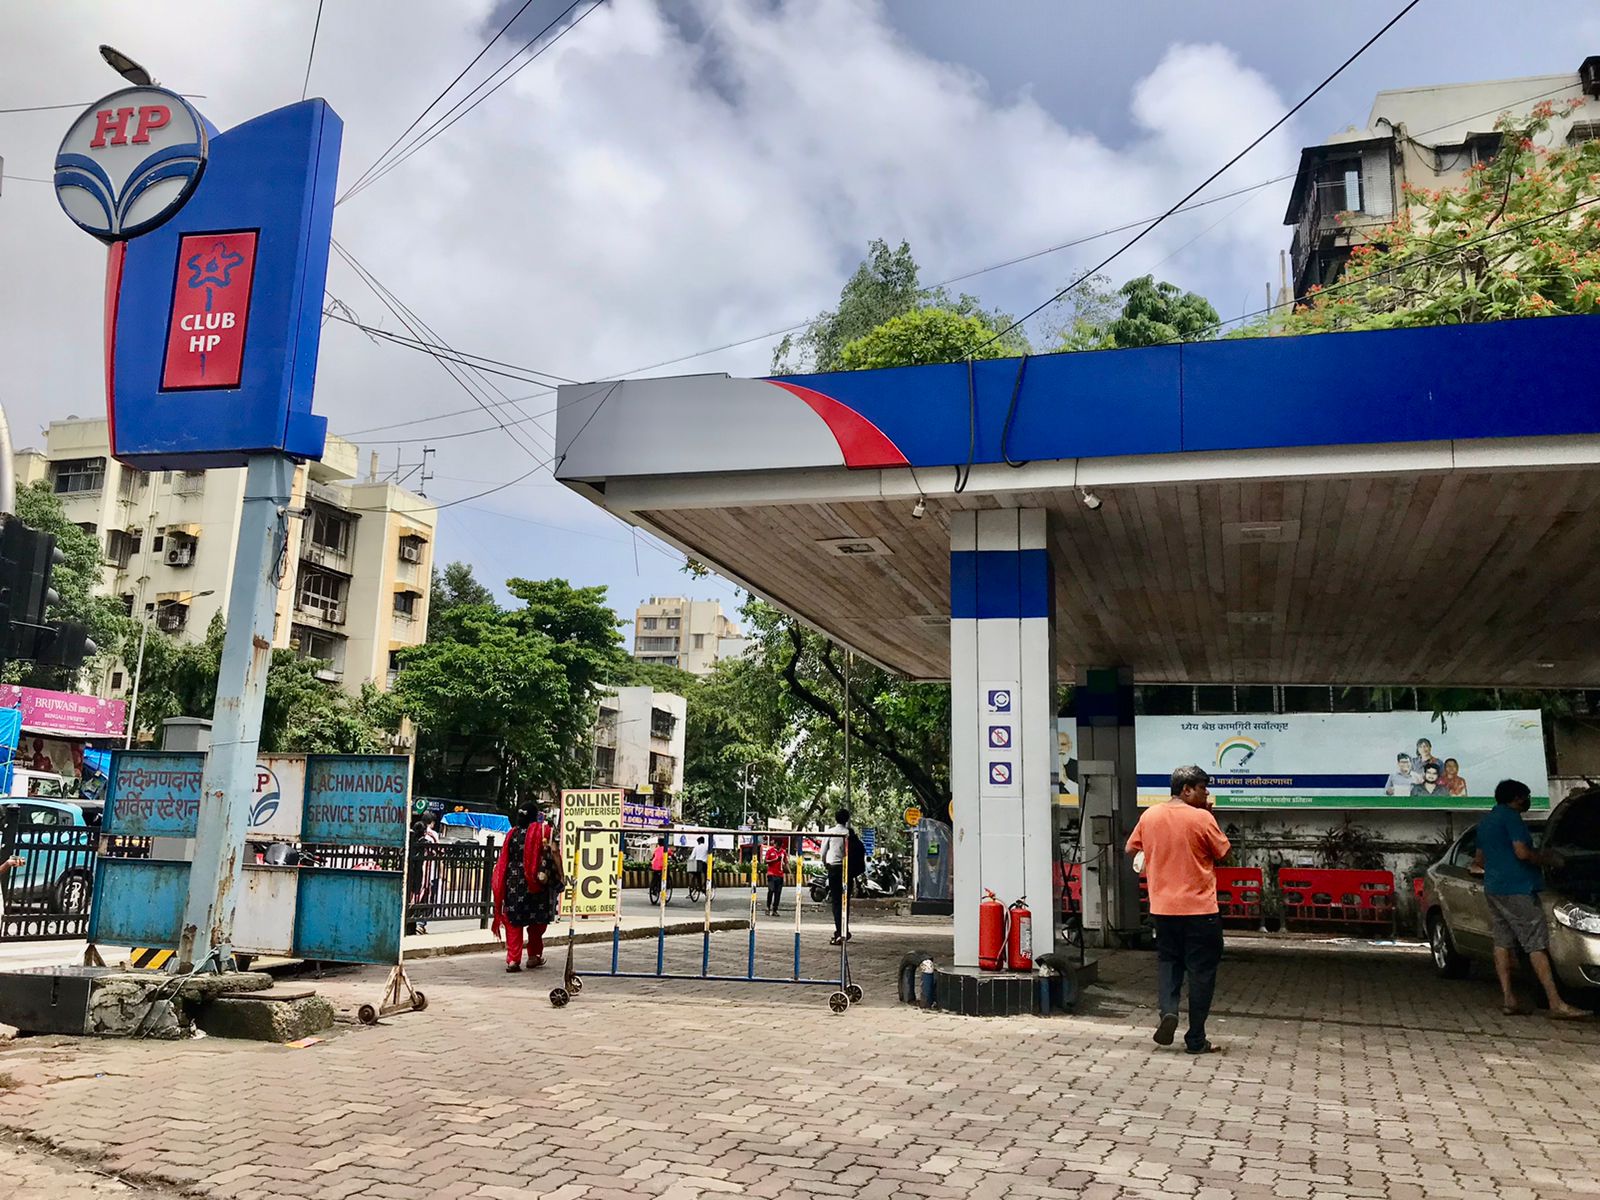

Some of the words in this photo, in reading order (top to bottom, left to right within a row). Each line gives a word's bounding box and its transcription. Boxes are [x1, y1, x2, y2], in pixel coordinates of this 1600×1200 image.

[90, 104, 172, 148] HP
[180, 312, 236, 331] CLUB
[189, 335, 221, 352] HP
[35, 697, 78, 712] BRIJWASI
[1217, 721, 1251, 730] कामगिरी
[251, 773, 270, 792] P
[310, 774, 404, 793] LACHMANDAS
[565, 793, 620, 807] ONLINE
[308, 805, 354, 823] SERVICE
[359, 805, 407, 824] STATION
[564, 807, 620, 816] COMPUTERISED
[562, 905, 582, 913] PETOL
[586, 905, 597, 913] CNG
